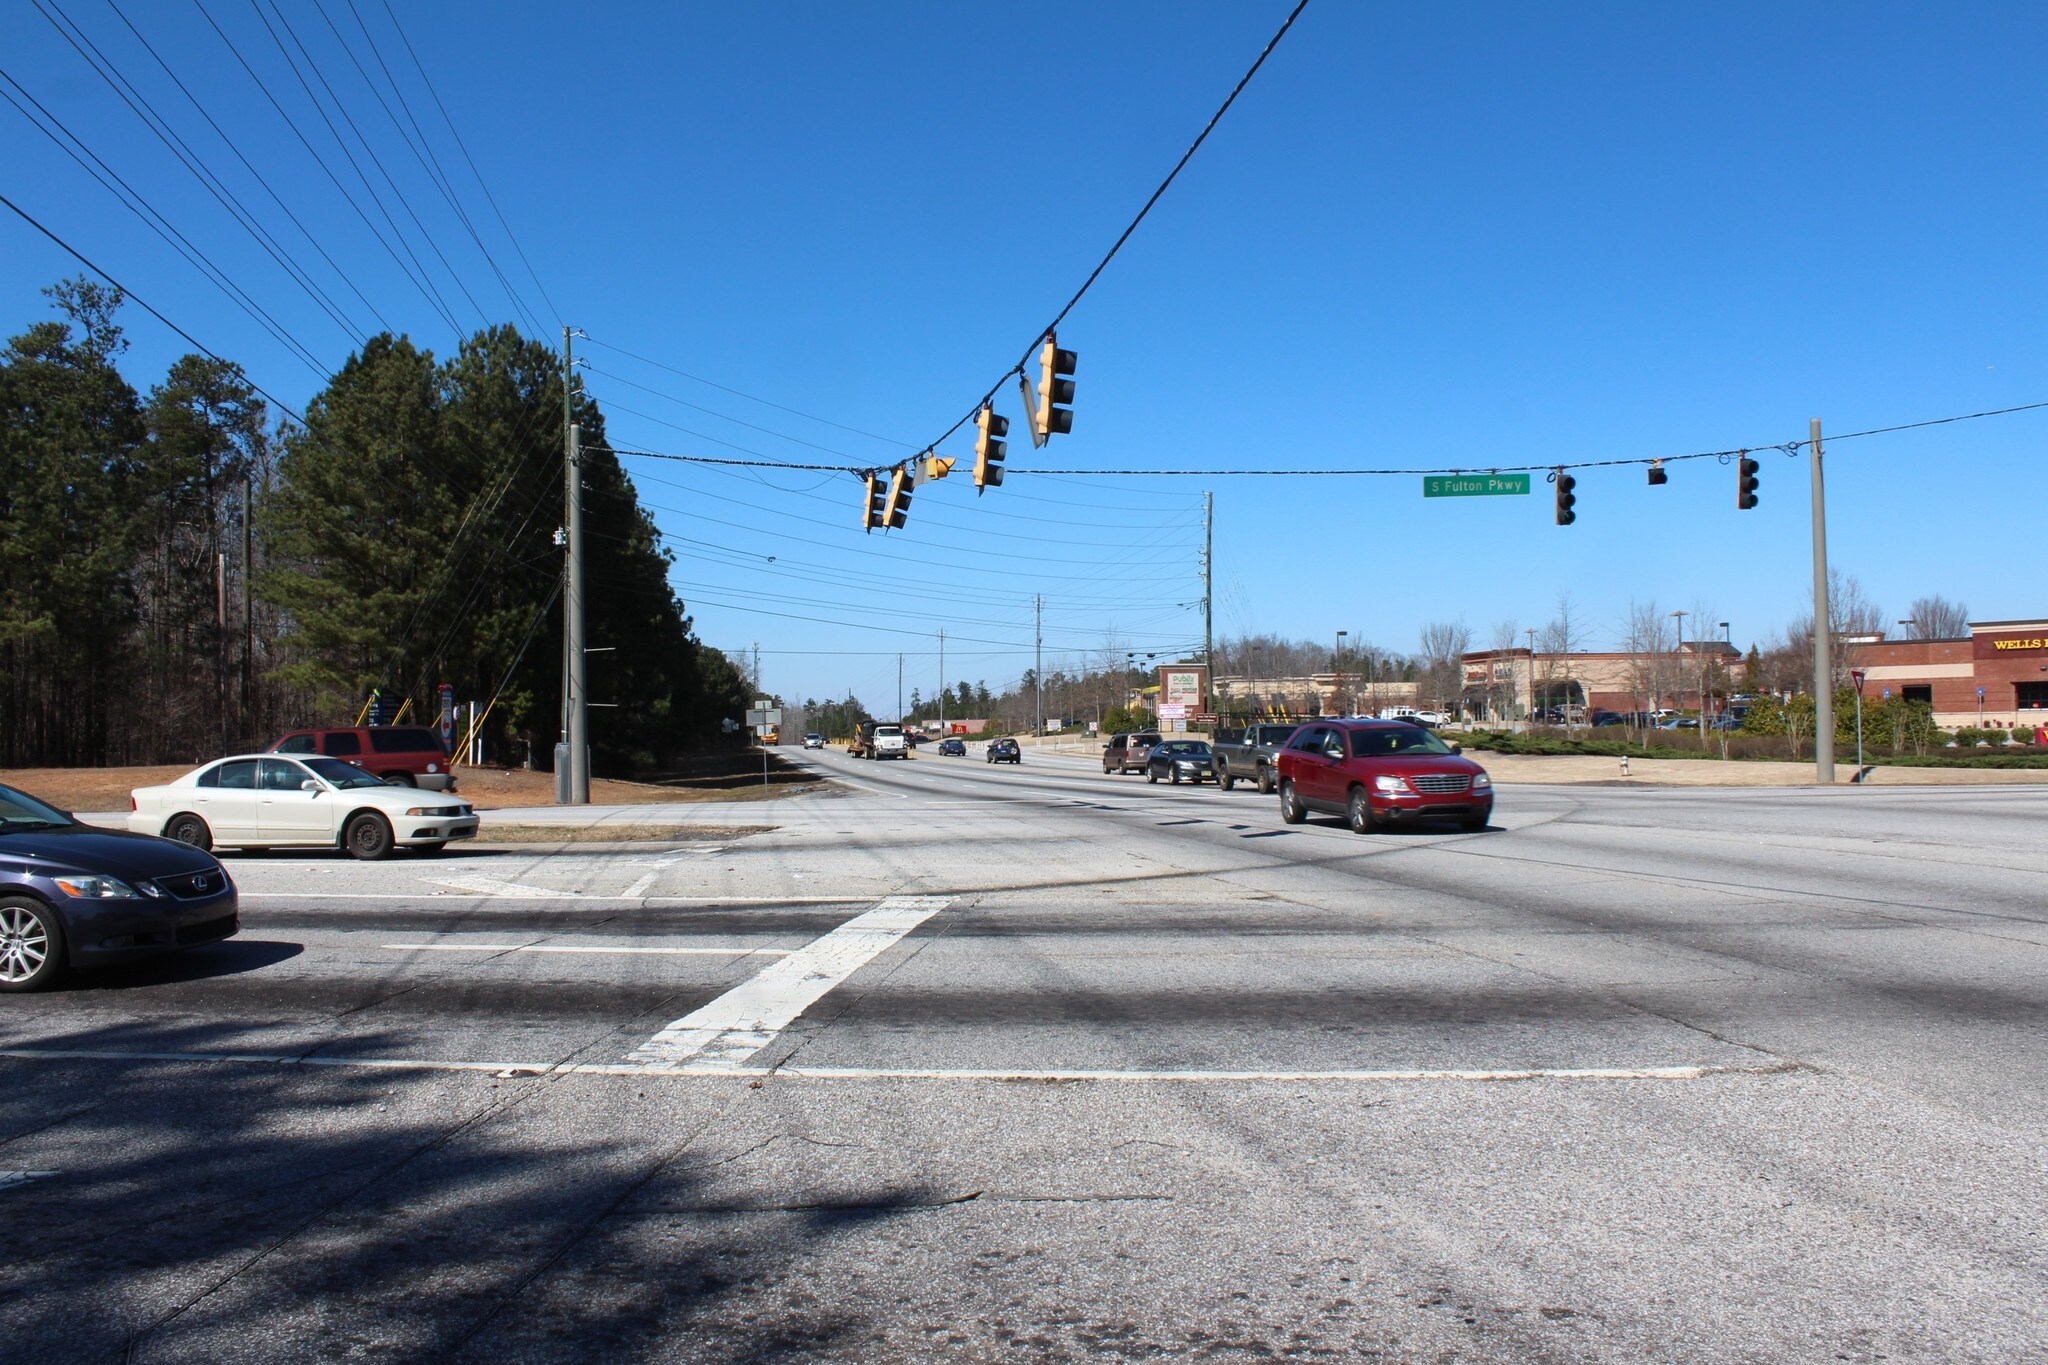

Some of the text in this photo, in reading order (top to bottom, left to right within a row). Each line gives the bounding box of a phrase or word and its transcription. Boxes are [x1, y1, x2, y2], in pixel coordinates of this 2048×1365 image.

[1432, 479, 1522, 492] S Fulton Pkwy
[1994, 639, 2041, 649] WELLS
